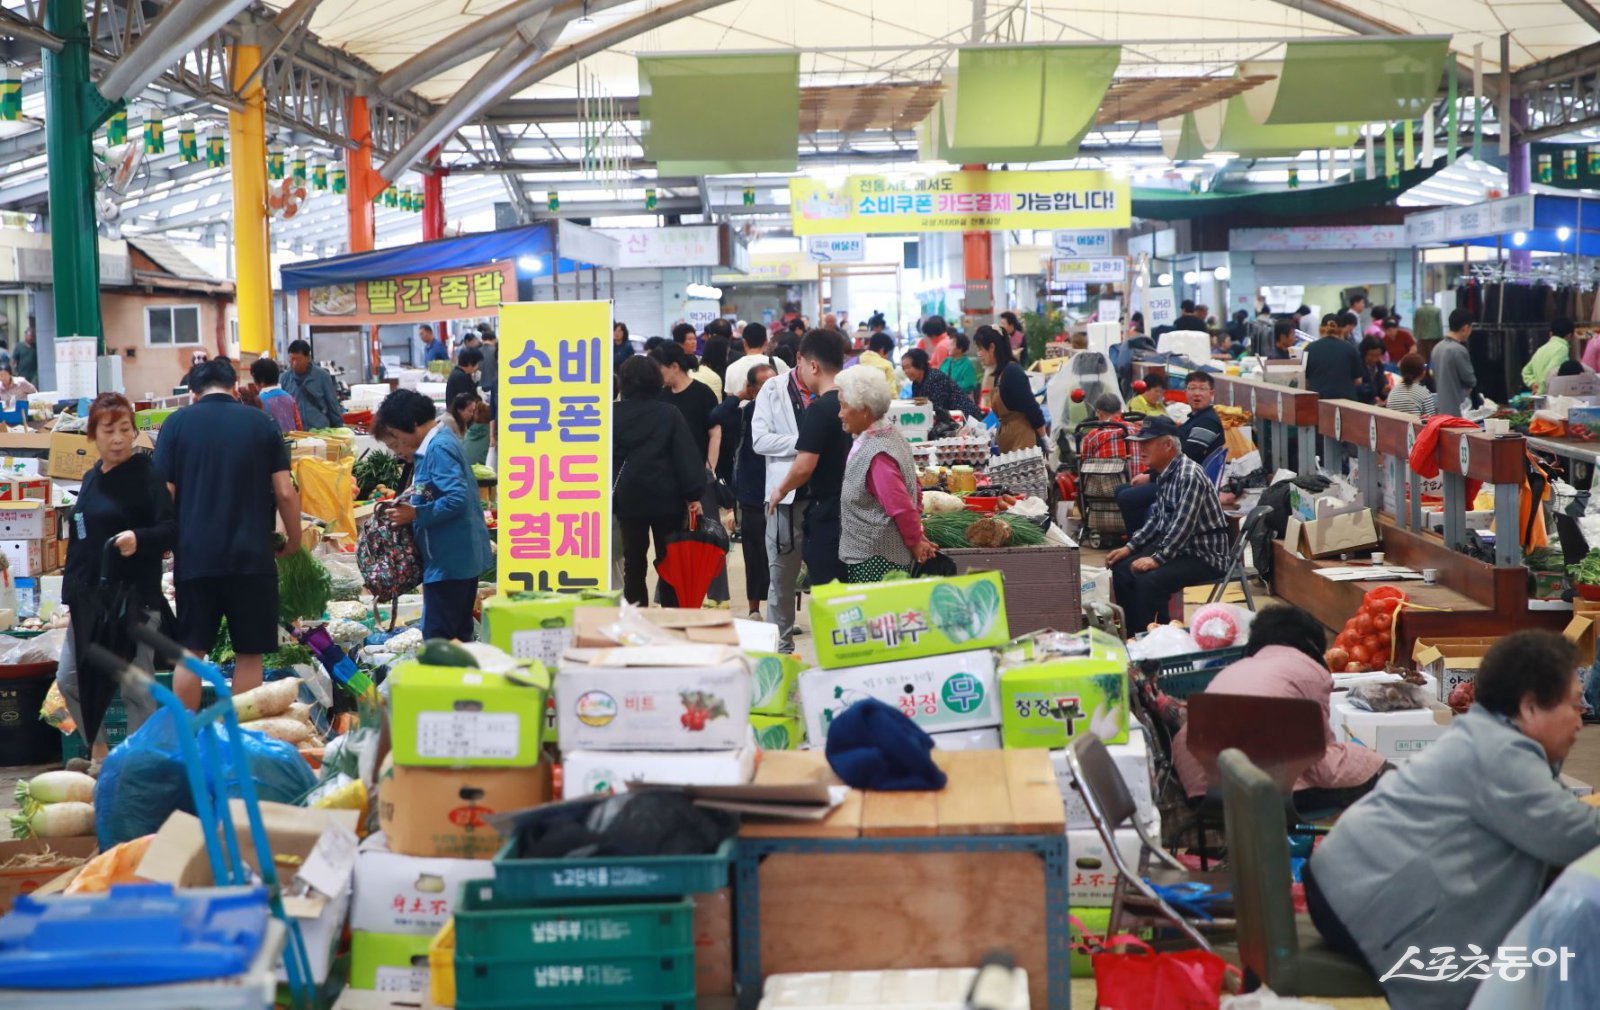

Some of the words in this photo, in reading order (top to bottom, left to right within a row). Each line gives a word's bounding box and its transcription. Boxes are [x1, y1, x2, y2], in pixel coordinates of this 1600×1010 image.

[859, 195, 932, 213] 소비쿠폰
[938, 192, 1011, 212] 카드결제
[1016, 191, 1114, 211] 가능합니다!
[860, 177, 953, 192] 전통시에서도
[367, 279, 432, 314] 빨간
[439, 271, 504, 309] 족발
[508, 337, 601, 385] 소비
[508, 396, 601, 443] 쿠폰
[508, 454, 601, 501] 카드
[508, 511, 600, 559] 결제
[898, 692, 937, 718] 청정
[947, 679, 980, 710] 무
[1015, 699, 1050, 718] 청정
